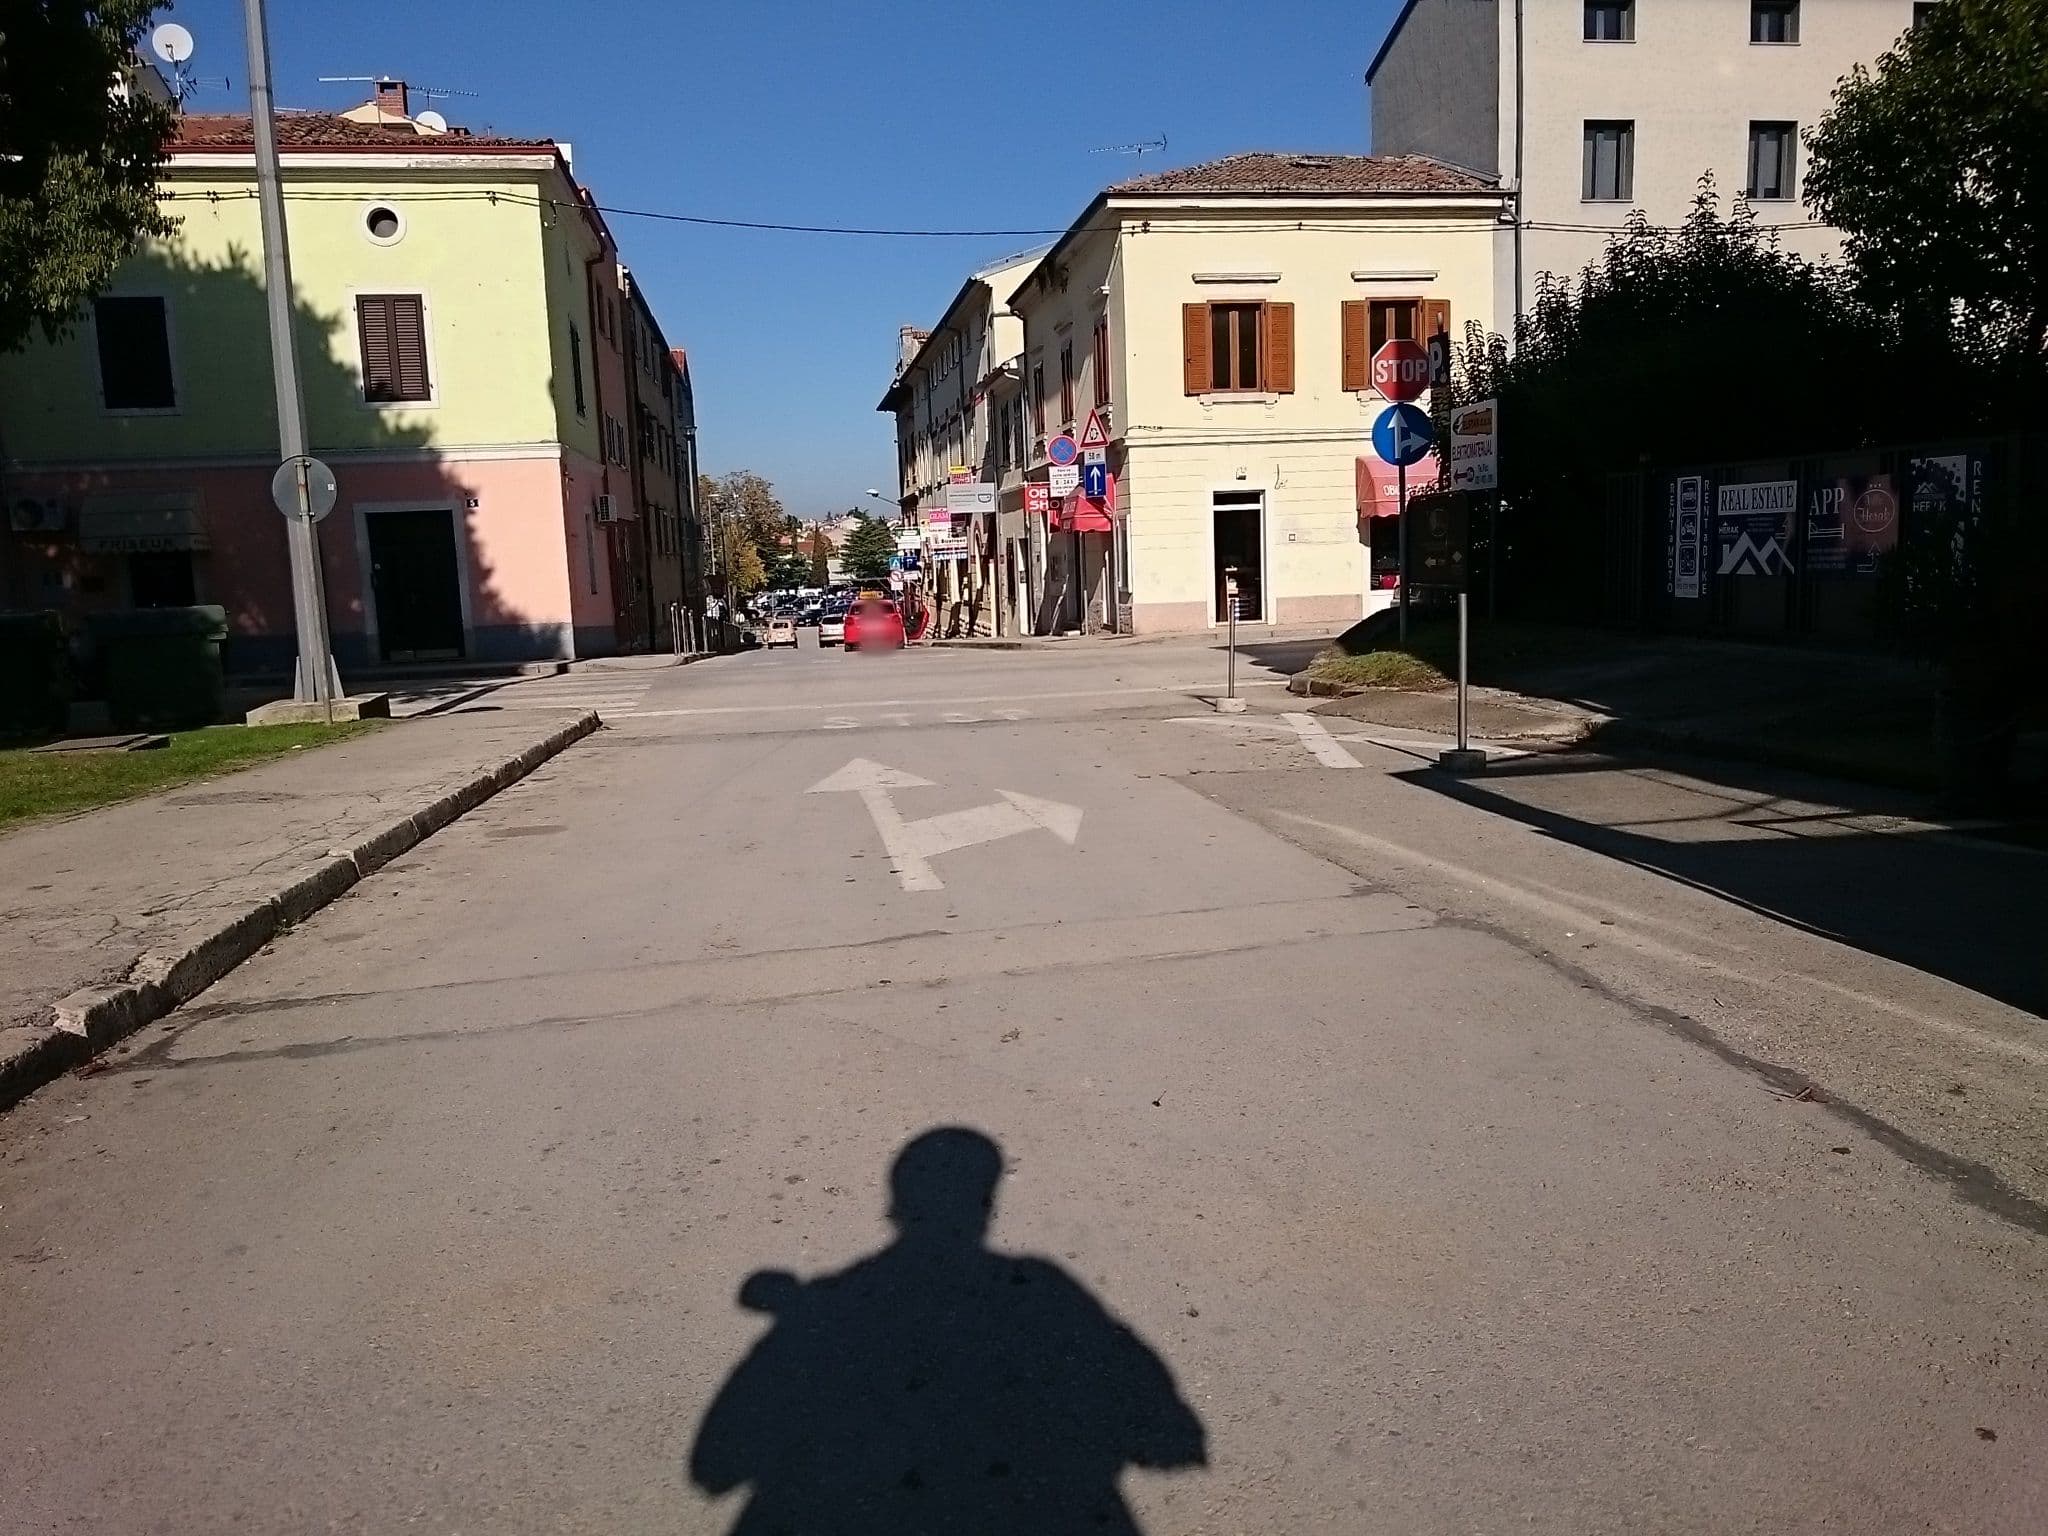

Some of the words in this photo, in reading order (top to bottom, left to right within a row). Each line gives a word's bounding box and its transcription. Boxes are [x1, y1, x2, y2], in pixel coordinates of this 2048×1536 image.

[1375, 359, 1428, 383] STOP
[1028, 488, 1048, 499] OB
[1720, 488, 1749, 512] REAL
[1751, 486, 1795, 509] ESTATE
[1809, 487, 1845, 515] APP
